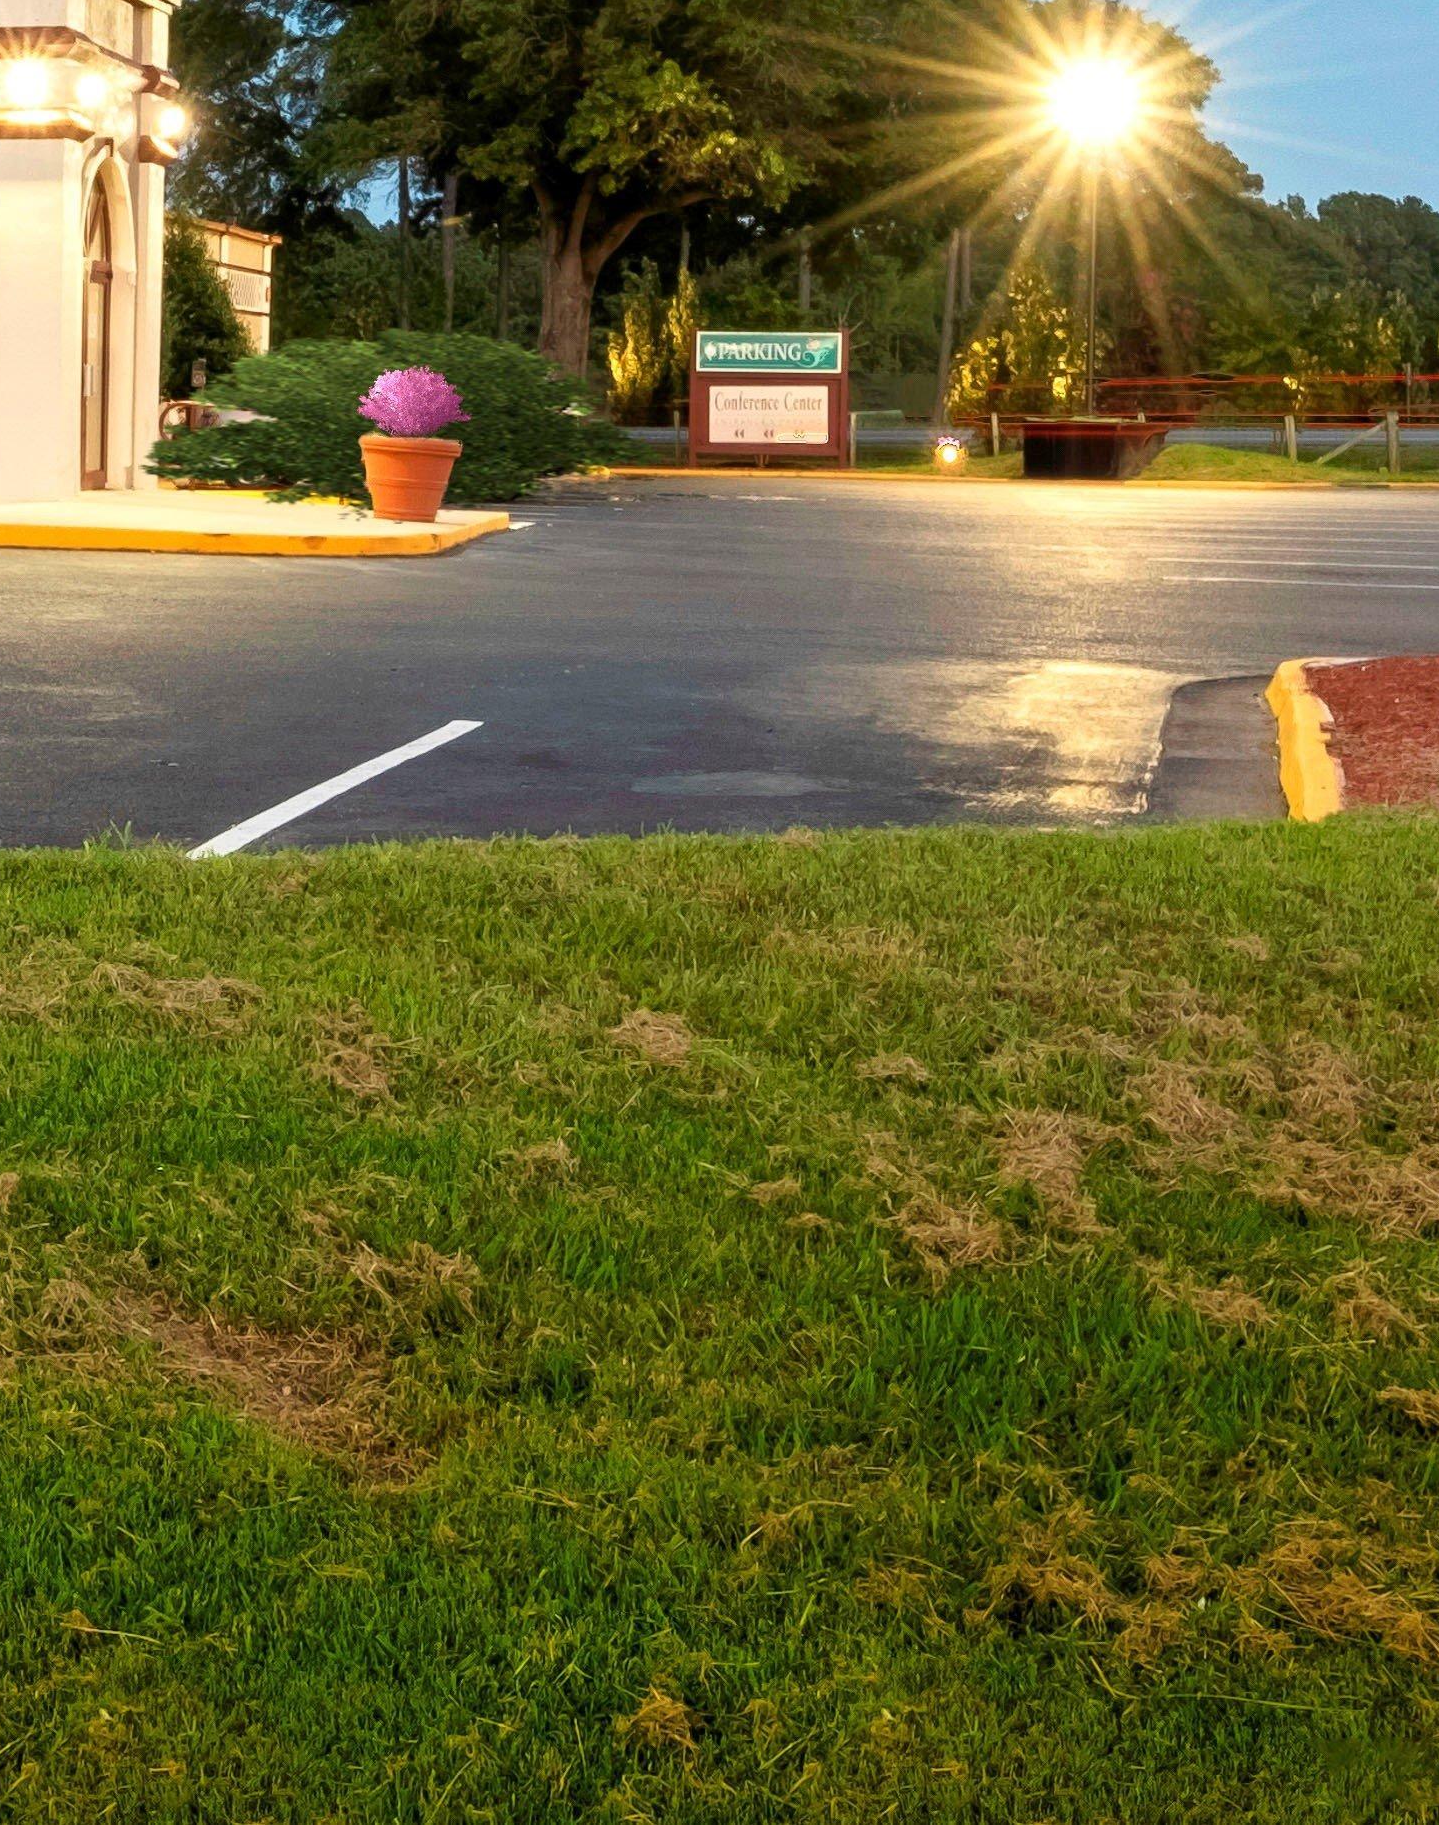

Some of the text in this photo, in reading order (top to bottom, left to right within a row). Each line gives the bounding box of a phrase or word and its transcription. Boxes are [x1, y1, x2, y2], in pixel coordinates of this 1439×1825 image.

[718, 341, 802, 362] PARKING
[714, 391, 823, 412] Conference Center
